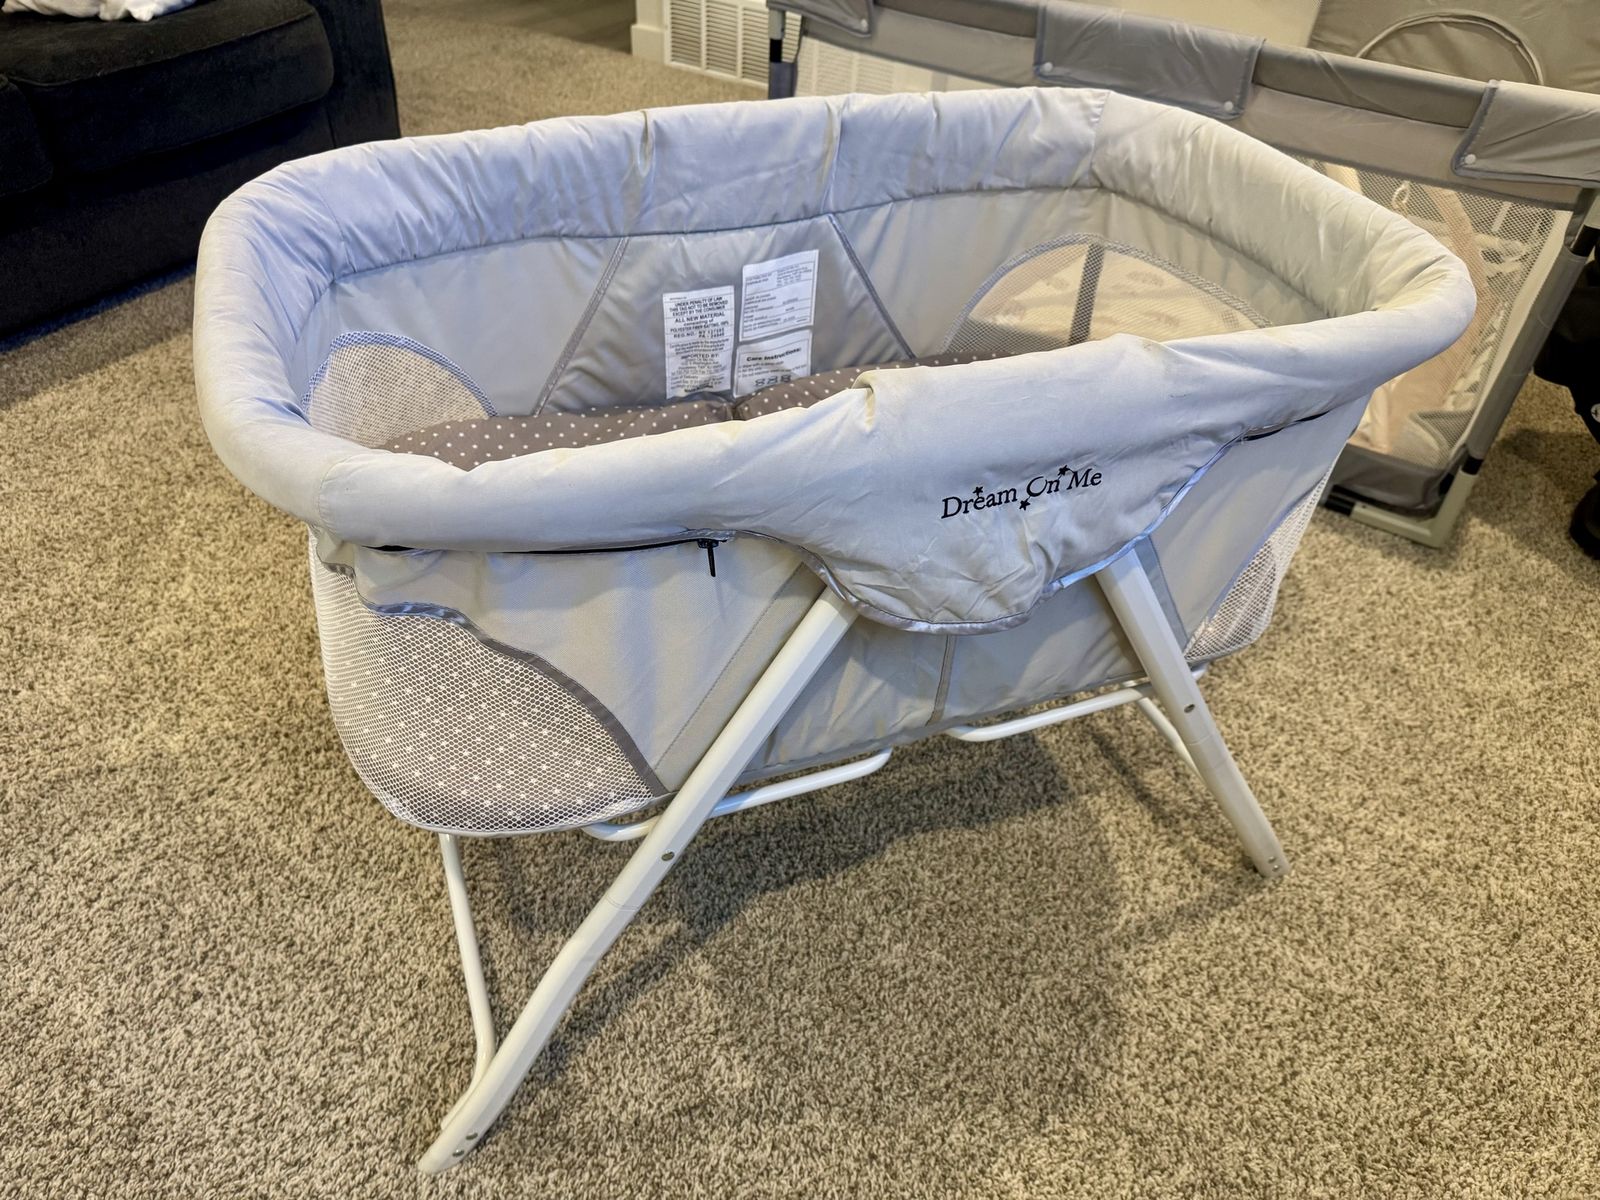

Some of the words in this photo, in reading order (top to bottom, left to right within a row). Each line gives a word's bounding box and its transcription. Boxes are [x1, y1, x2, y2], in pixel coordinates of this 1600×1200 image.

[940, 488, 1018, 519] Dream
[1026, 476, 1060, 498] On
[1066, 468, 1102, 490] Me
